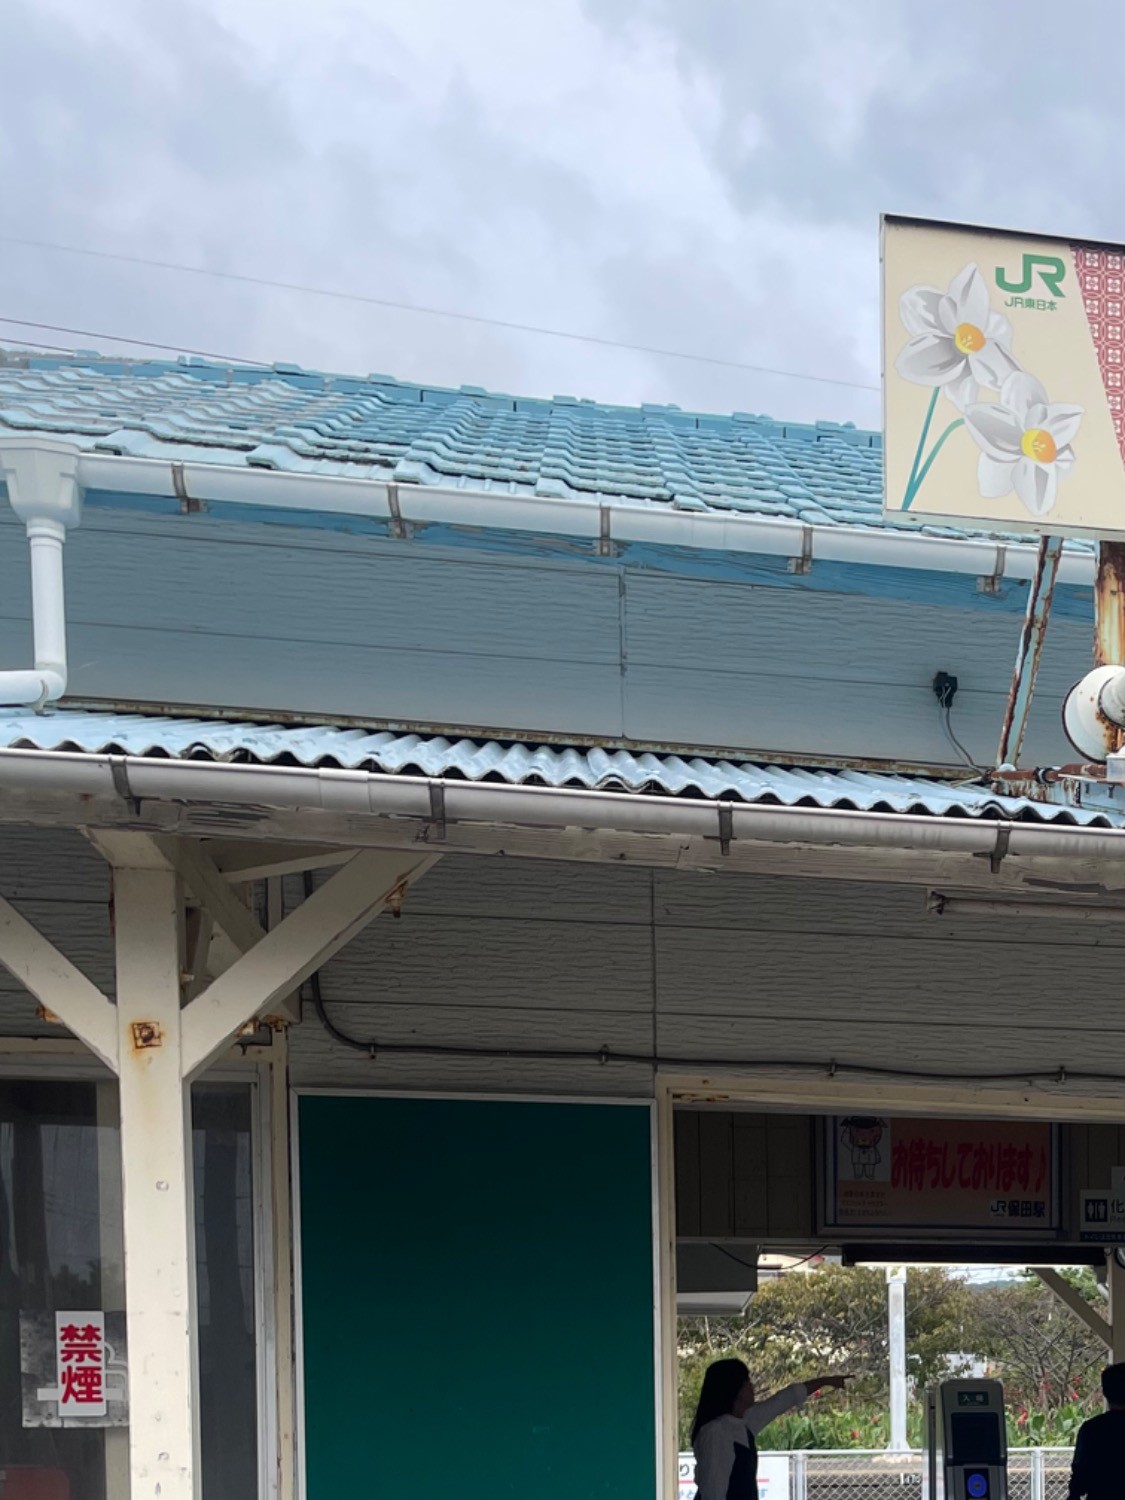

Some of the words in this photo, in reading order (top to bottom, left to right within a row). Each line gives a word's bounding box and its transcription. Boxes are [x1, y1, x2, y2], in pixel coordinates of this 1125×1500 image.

[995, 253, 1066, 298] JR
[1004, 296, 1058, 311] JR東日本
[60, 1323, 103, 1403] 禁煙
